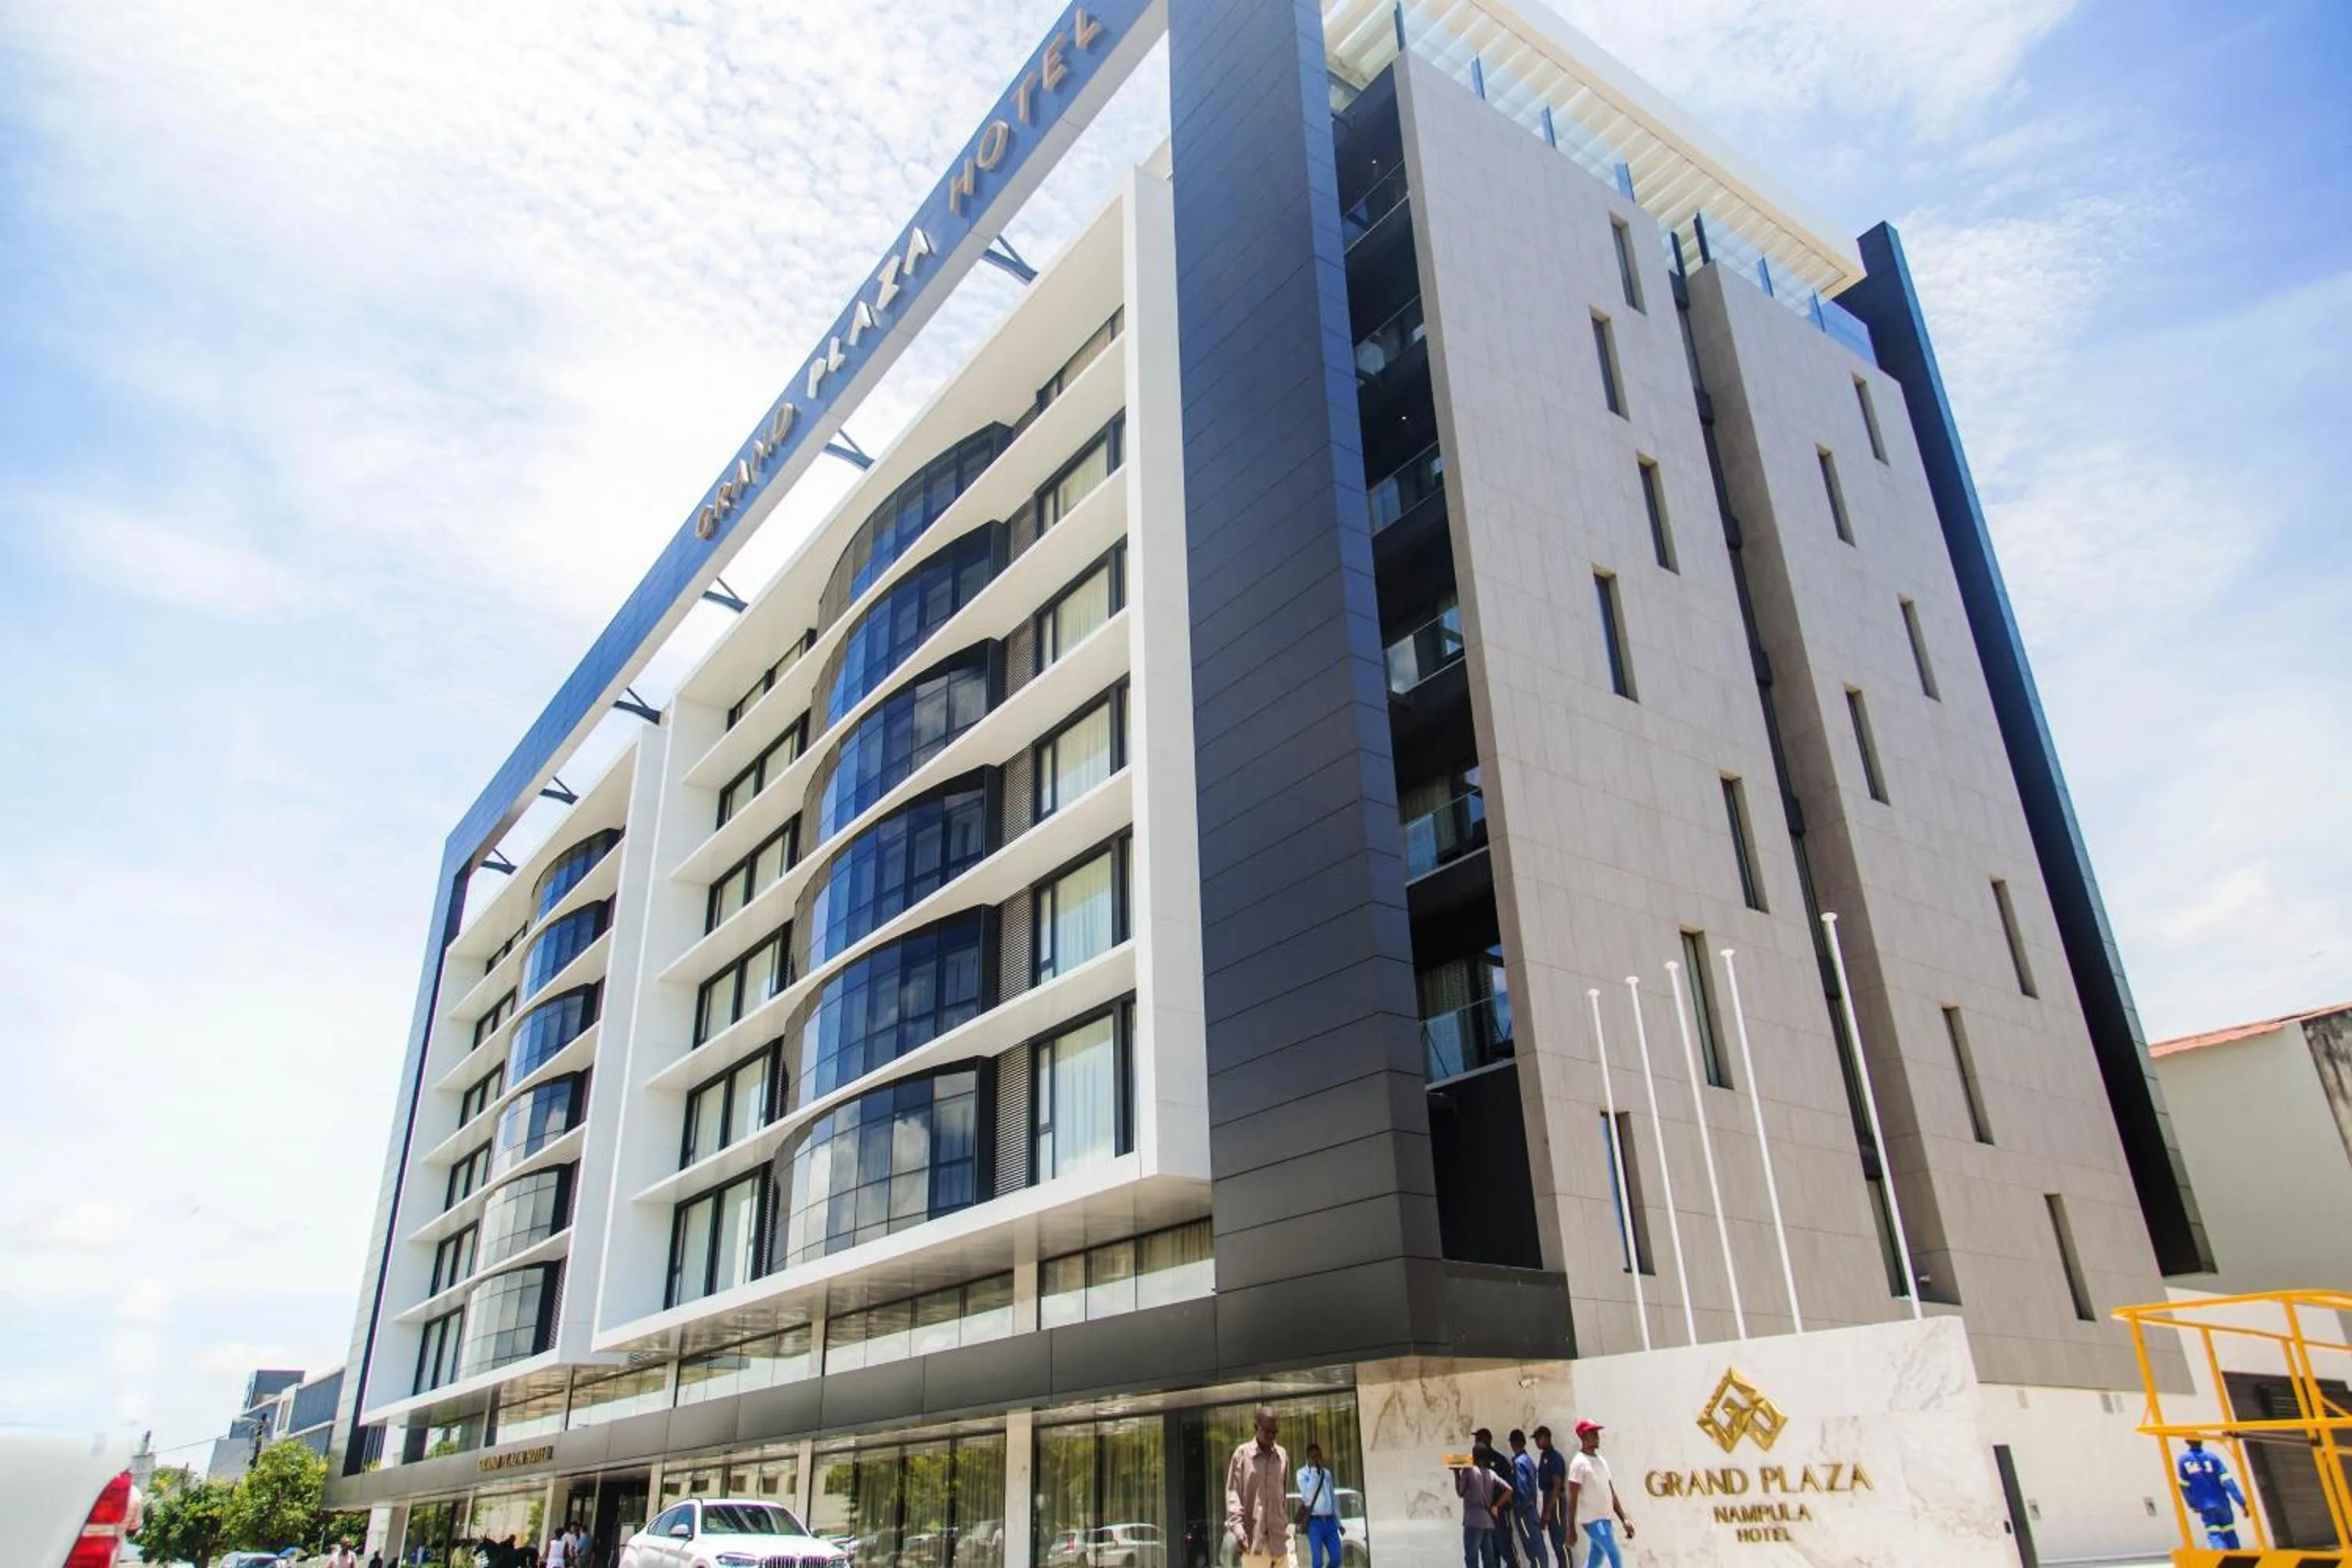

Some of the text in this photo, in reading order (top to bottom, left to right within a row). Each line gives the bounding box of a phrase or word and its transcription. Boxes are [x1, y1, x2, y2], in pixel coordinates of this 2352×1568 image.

[696, 6, 1102, 540] GRAND PLAZA HOTEL
[1644, 1462, 1875, 1497] GRAND PLAZA
[1713, 1502, 1813, 1523] NAMPULA
[1737, 1526, 1793, 1543] HOTEL
